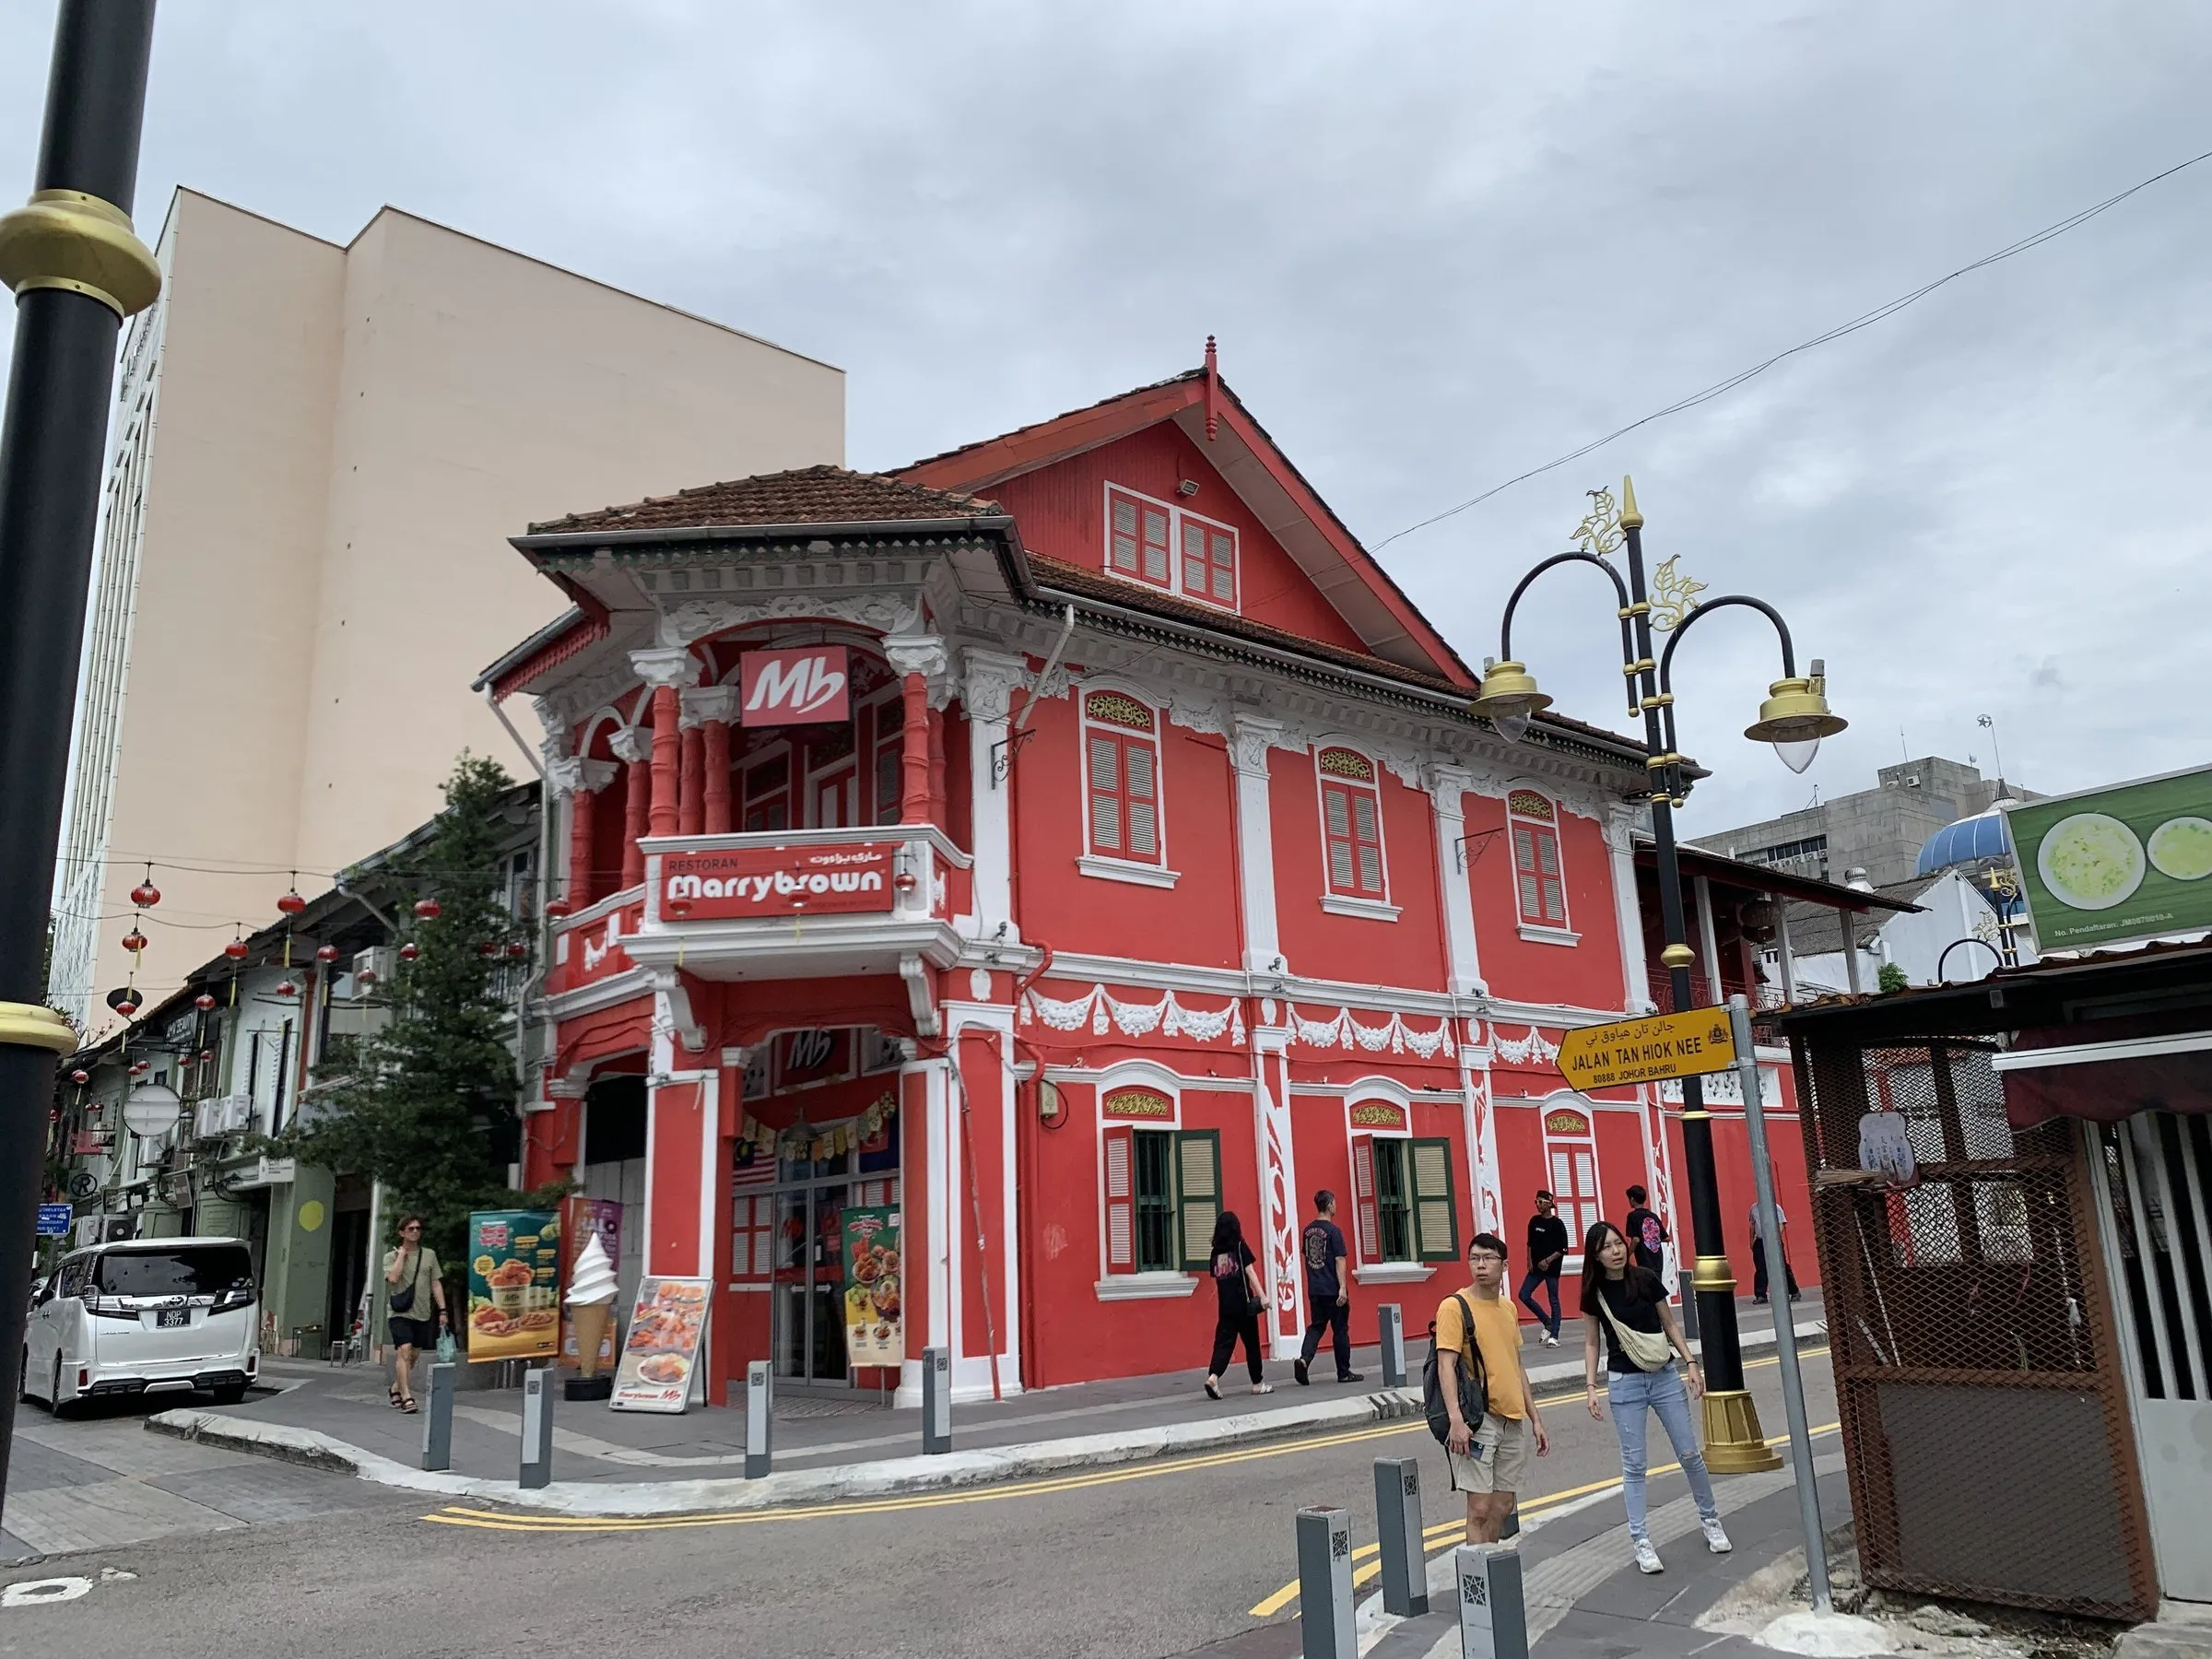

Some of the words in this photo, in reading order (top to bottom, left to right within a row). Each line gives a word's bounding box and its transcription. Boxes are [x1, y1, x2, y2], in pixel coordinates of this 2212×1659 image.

[745, 655, 845, 714] Mb
[669, 857, 738, 872] RESTORAN
[2054, 928, 2067, 938] No.
[2069, 922, 2119, 935] Pendaftaran:
[1571, 1051, 1610, 1071] JALAN
[1616, 1045, 1640, 1065] TAN
[1642, 1041, 1673, 1062] HIOK
[1677, 1037, 1702, 1055] NEE
[1618, 1068, 1646, 1081] JOHOR
[1648, 1064, 1677, 1077] BAHRU
[163, 1317, 183, 1327] 3377
